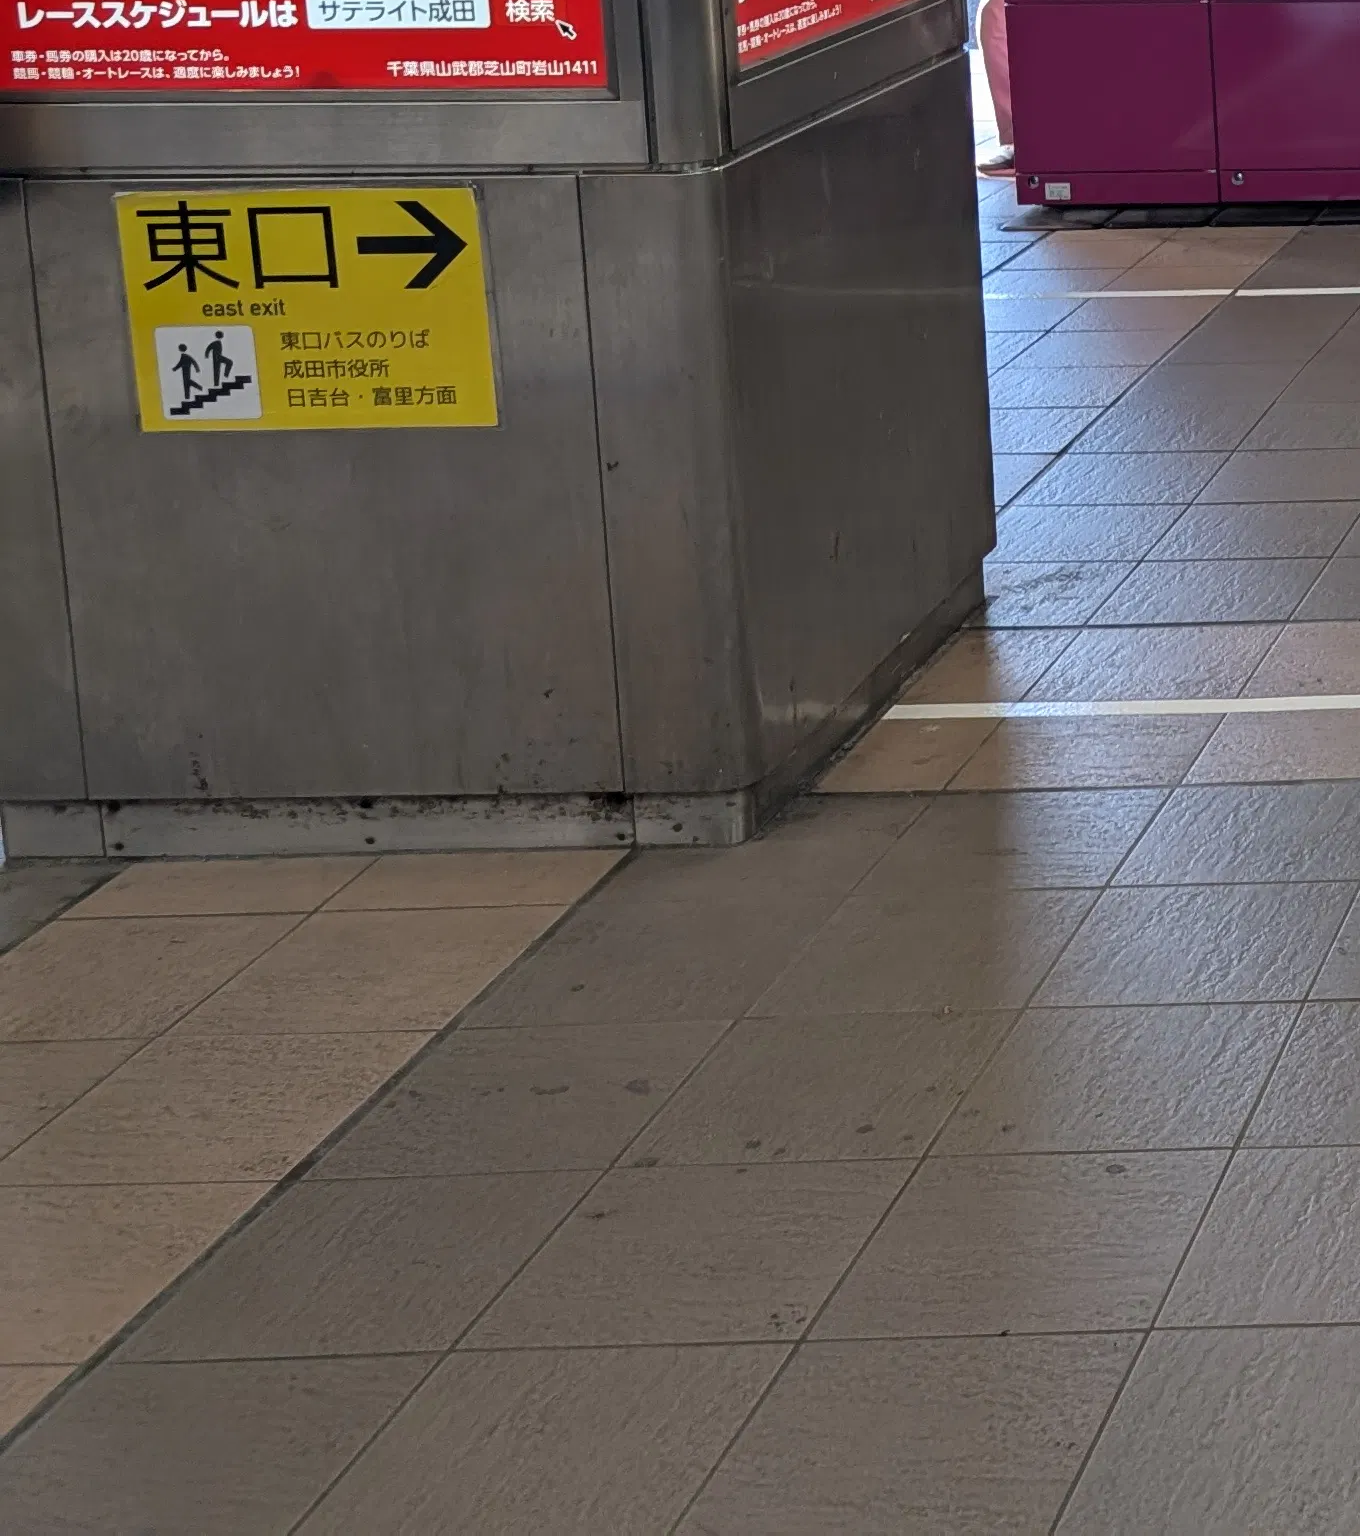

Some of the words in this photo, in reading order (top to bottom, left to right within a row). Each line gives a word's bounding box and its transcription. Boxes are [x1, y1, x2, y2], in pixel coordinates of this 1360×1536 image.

[17, 0, 299, 30] レーススケジュールは
[317, 0, 476, 23] サテライト成田
[11, 49, 230, 63] 車券・馬券の購入は20歳になってから。
[386, 60, 598, 78] 千葉県山武郡芝山町岩山1411
[136, 200, 339, 293] 東口
[202, 299, 245, 317] east
[250, 297, 286, 317] exit
[280, 329, 430, 352] 東口バスのりば
[283, 359, 390, 380] 成田市役所
[287, 386, 457, 408] 日吉台・富里方面
